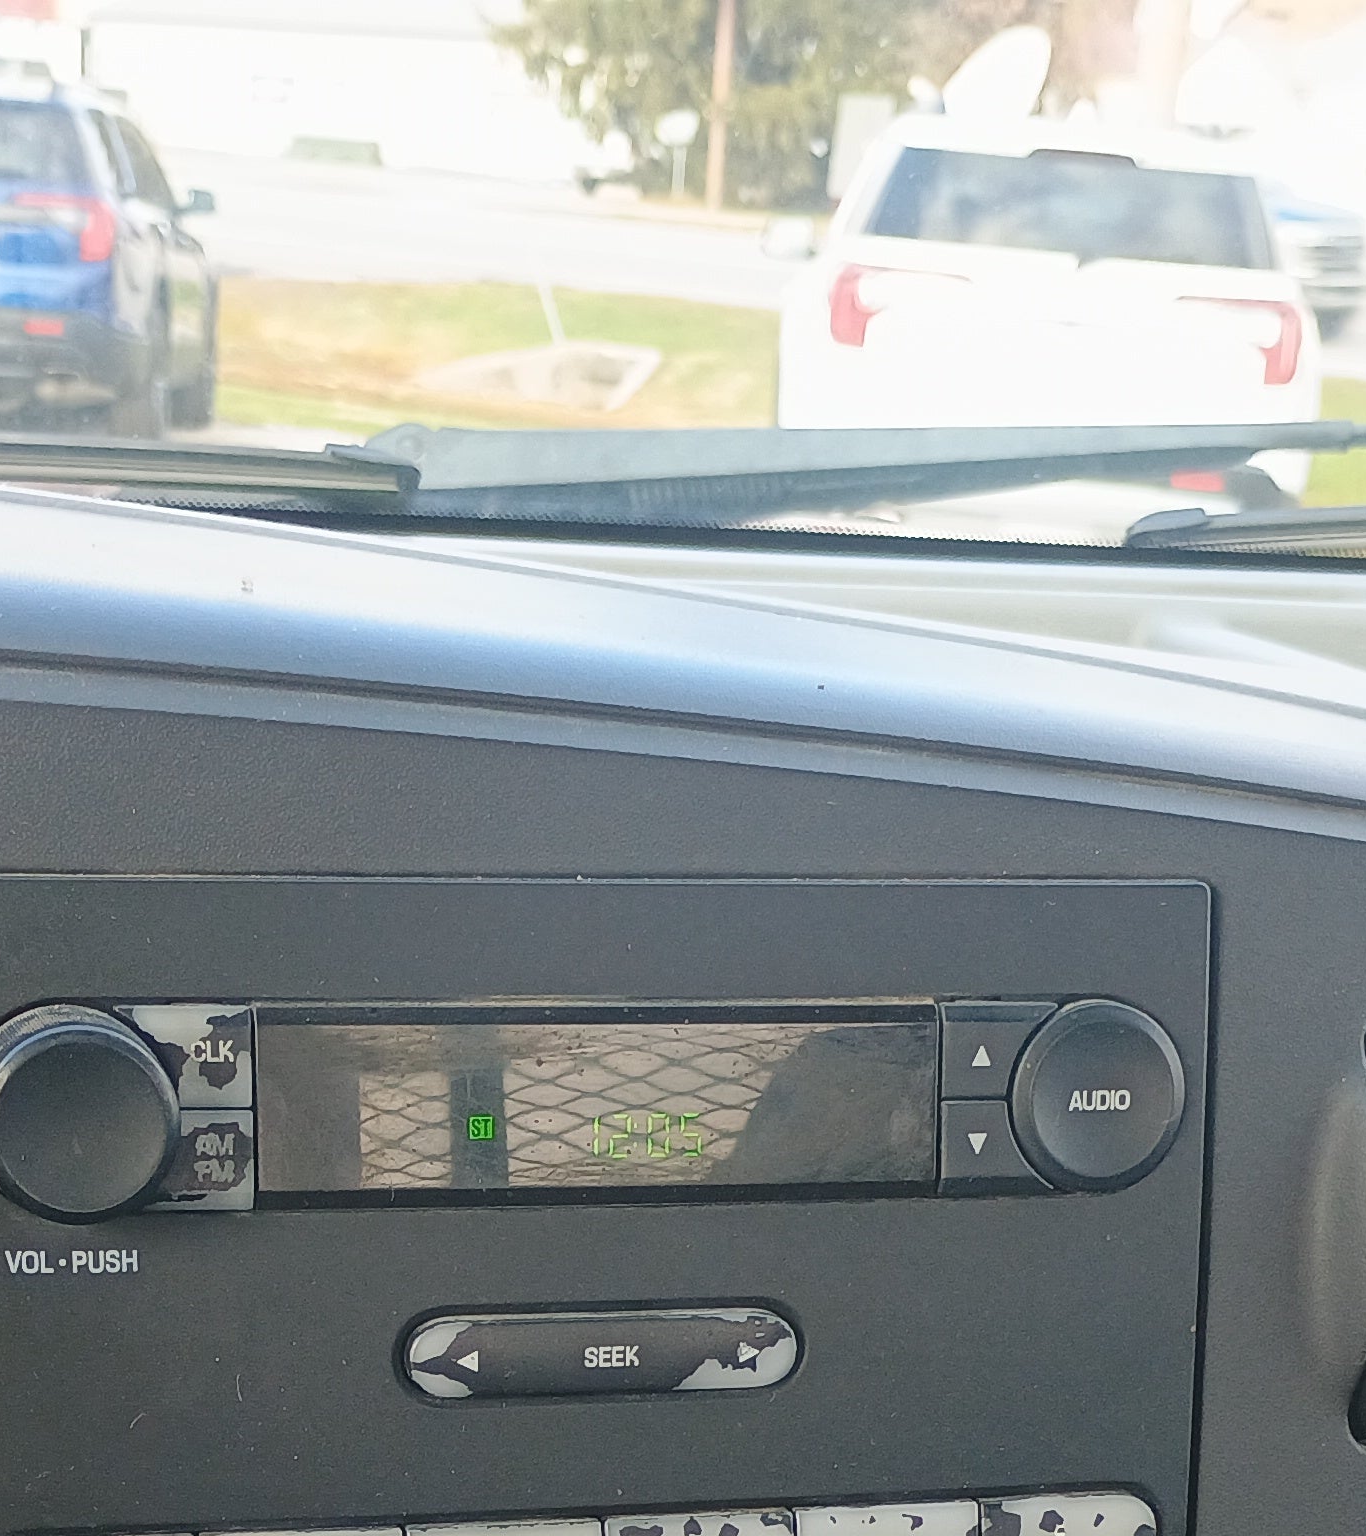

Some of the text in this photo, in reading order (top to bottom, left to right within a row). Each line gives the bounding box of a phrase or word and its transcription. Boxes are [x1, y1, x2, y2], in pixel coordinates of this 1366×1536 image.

[190, 1039, 235, 1063] CLK
[1068, 1088, 1131, 1112] AUDIO
[467, 1115, 496, 1140] ST
[593, 1112, 702, 1158] 12:05
[583, 1345, 640, 1368] SEEK
